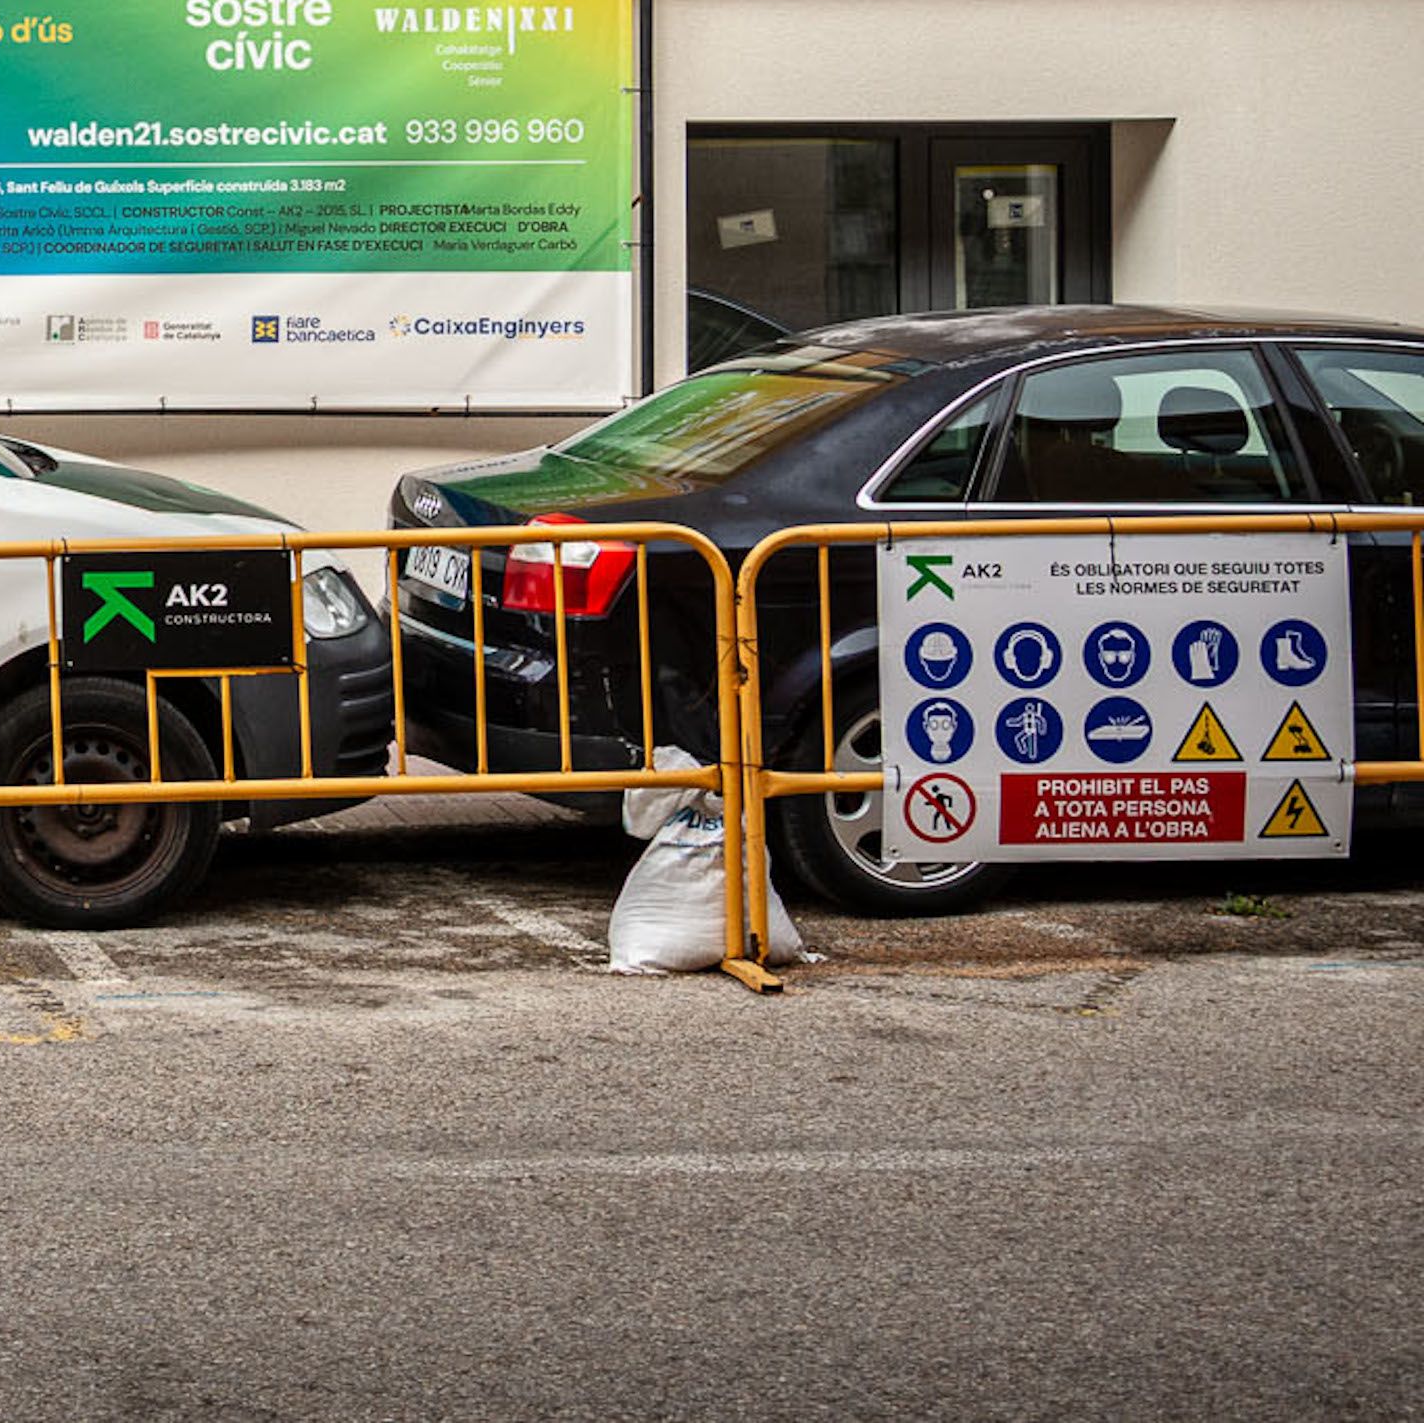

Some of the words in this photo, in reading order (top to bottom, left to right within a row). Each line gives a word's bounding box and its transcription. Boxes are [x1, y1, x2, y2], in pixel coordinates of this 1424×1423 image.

[374, 7, 502, 32] WALDEN
[520, 7, 574, 30] XXI
[206, 31, 312, 70] cívic
[28, 120, 387, 147] walden21.sostrecivic.cat
[406, 119, 456, 144] 933
[465, 119, 519, 144] 996
[527, 119, 585, 144] 960
[7, 181, 39, 194] Sant
[41, 181, 72, 194] Feliu
[75, 181, 92, 194] de
[290, 180, 322, 192] 3.183
[324, 180, 345, 191] m2
[122, 206, 223, 218] CONSTRUCTOR
[379, 222, 446, 233] DIRECTOR
[450, 221, 507, 233] EXECUCI
[44, 241, 145, 254] COORDINADOR
[149, 241, 166, 253] DE
[169, 241, 243, 253] SEGURETAT
[253, 240, 294, 252] SALUT
[297, 240, 315, 251] EN
[317, 240, 350, 251] FASE
[286, 315, 320, 329] fiare
[414, 317, 585, 339] CaixaEnginyers
[962, 564, 1002, 578] AK2
[1050, 562, 1070, 576] ÉS
[1075, 562, 1169, 577] OBLIGATORI
[1174, 562, 1207, 576] QUE
[1211, 562, 1269, 576] SEGUIU
[1273, 561, 1324, 575] TOTES
[165, 583, 228, 607] AK2
[1077, 582, 1104, 595] LES
[1110, 581, 1177, 594] NORMES
[1181, 581, 1202, 594] DE
[1207, 580, 1301, 594] SEGURETAT
[164, 612, 272, 625] CONSTRUCTORA
[1037, 779, 1135, 796] PROHIBIT
[1140, 779, 1165, 795] EL
[1170, 778, 1210, 795] PAS
[1034, 801, 1050, 817] A
[1054, 801, 1108, 817] TOTA
[1112, 799, 1211, 816] PERSONA
[1035, 822, 1110, 839] ALIENA
[1114, 821, 1129, 838] A
[1134, 821, 1209, 838] L'OBRA
